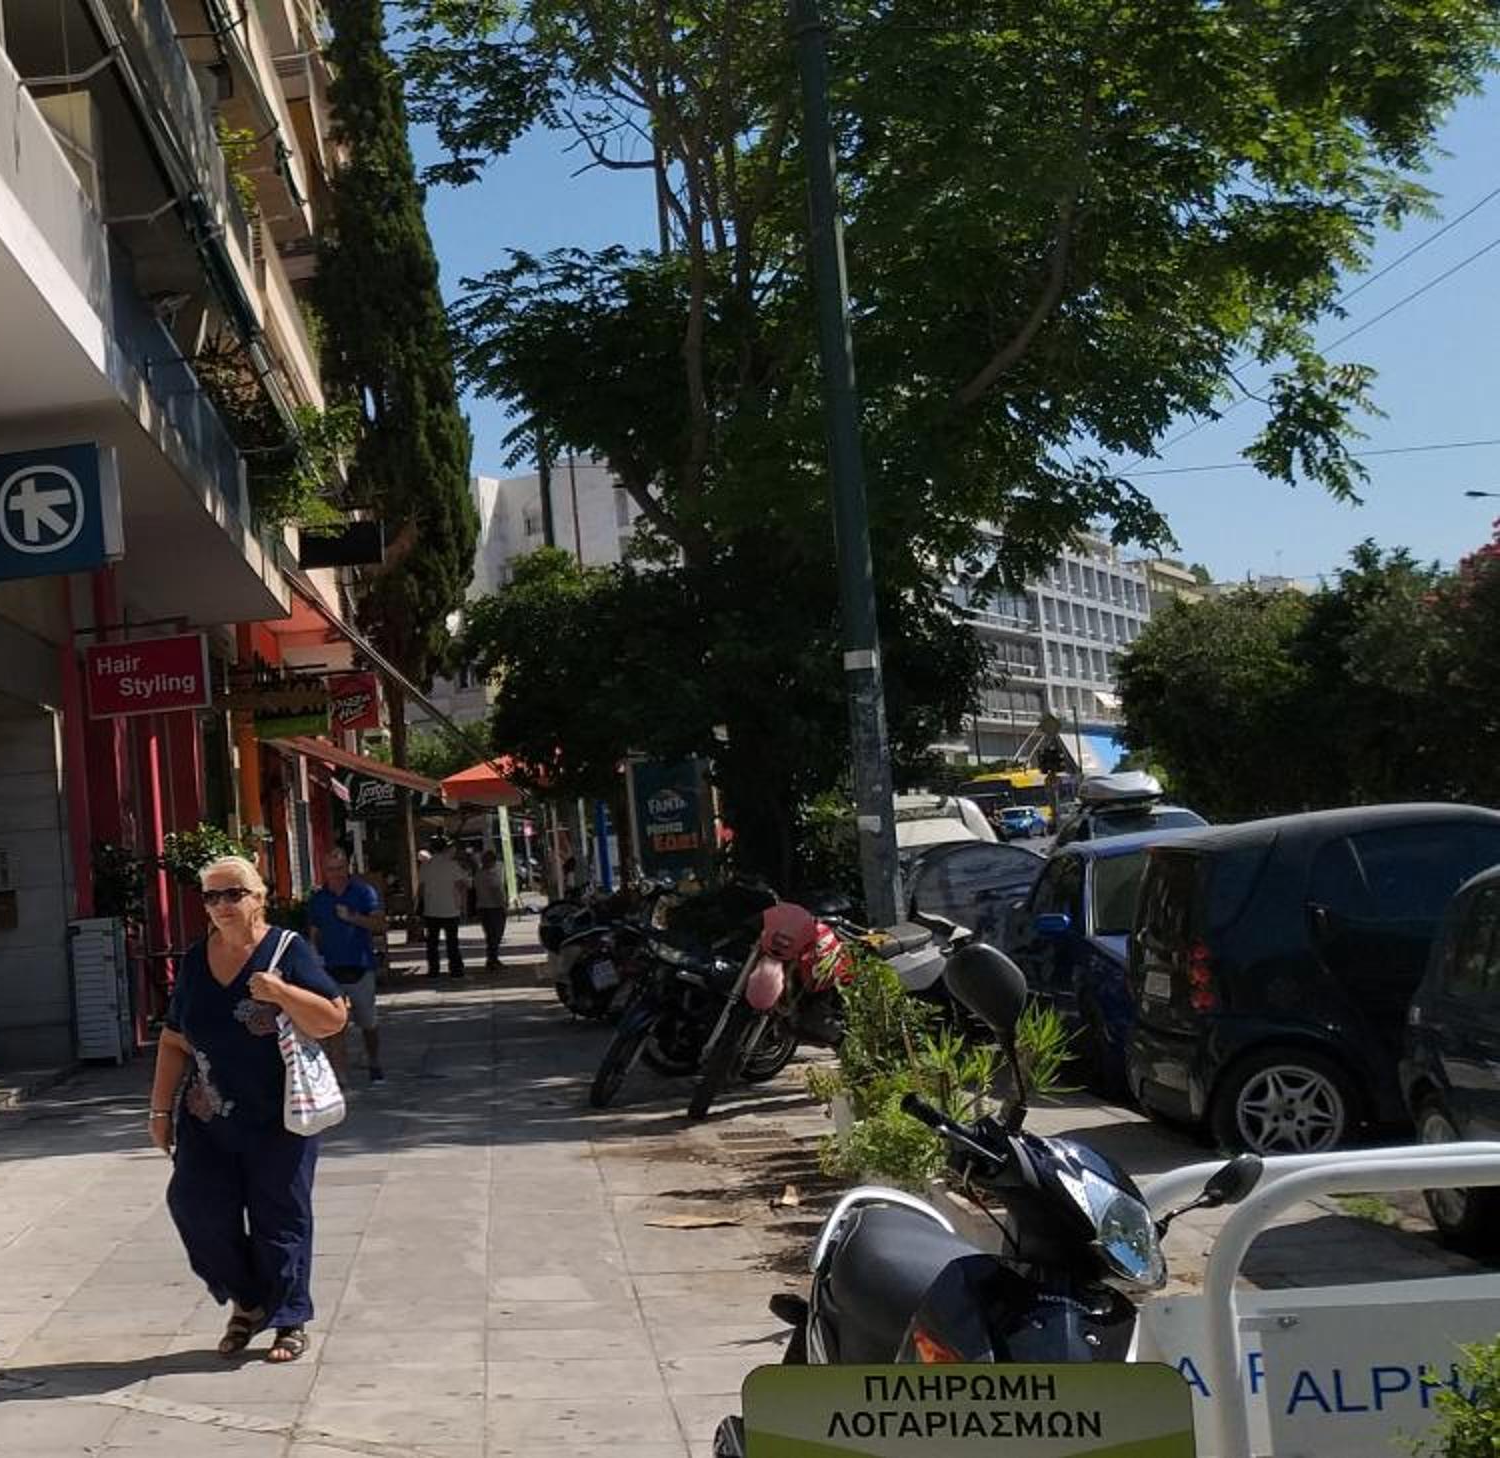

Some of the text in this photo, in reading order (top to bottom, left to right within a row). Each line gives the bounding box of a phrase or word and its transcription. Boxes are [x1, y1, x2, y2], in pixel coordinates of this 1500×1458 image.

[97, 655, 141, 676] Hair
[119, 673, 196, 699] Styling
[864, 1375, 1056, 1401] ΠΛΗΡΩΜΗ
[1286, 1363, 1479, 1415] ALPH
[827, 1411, 1102, 1438] ΛΟΓΑΡΙΑΣΜΩΝ
